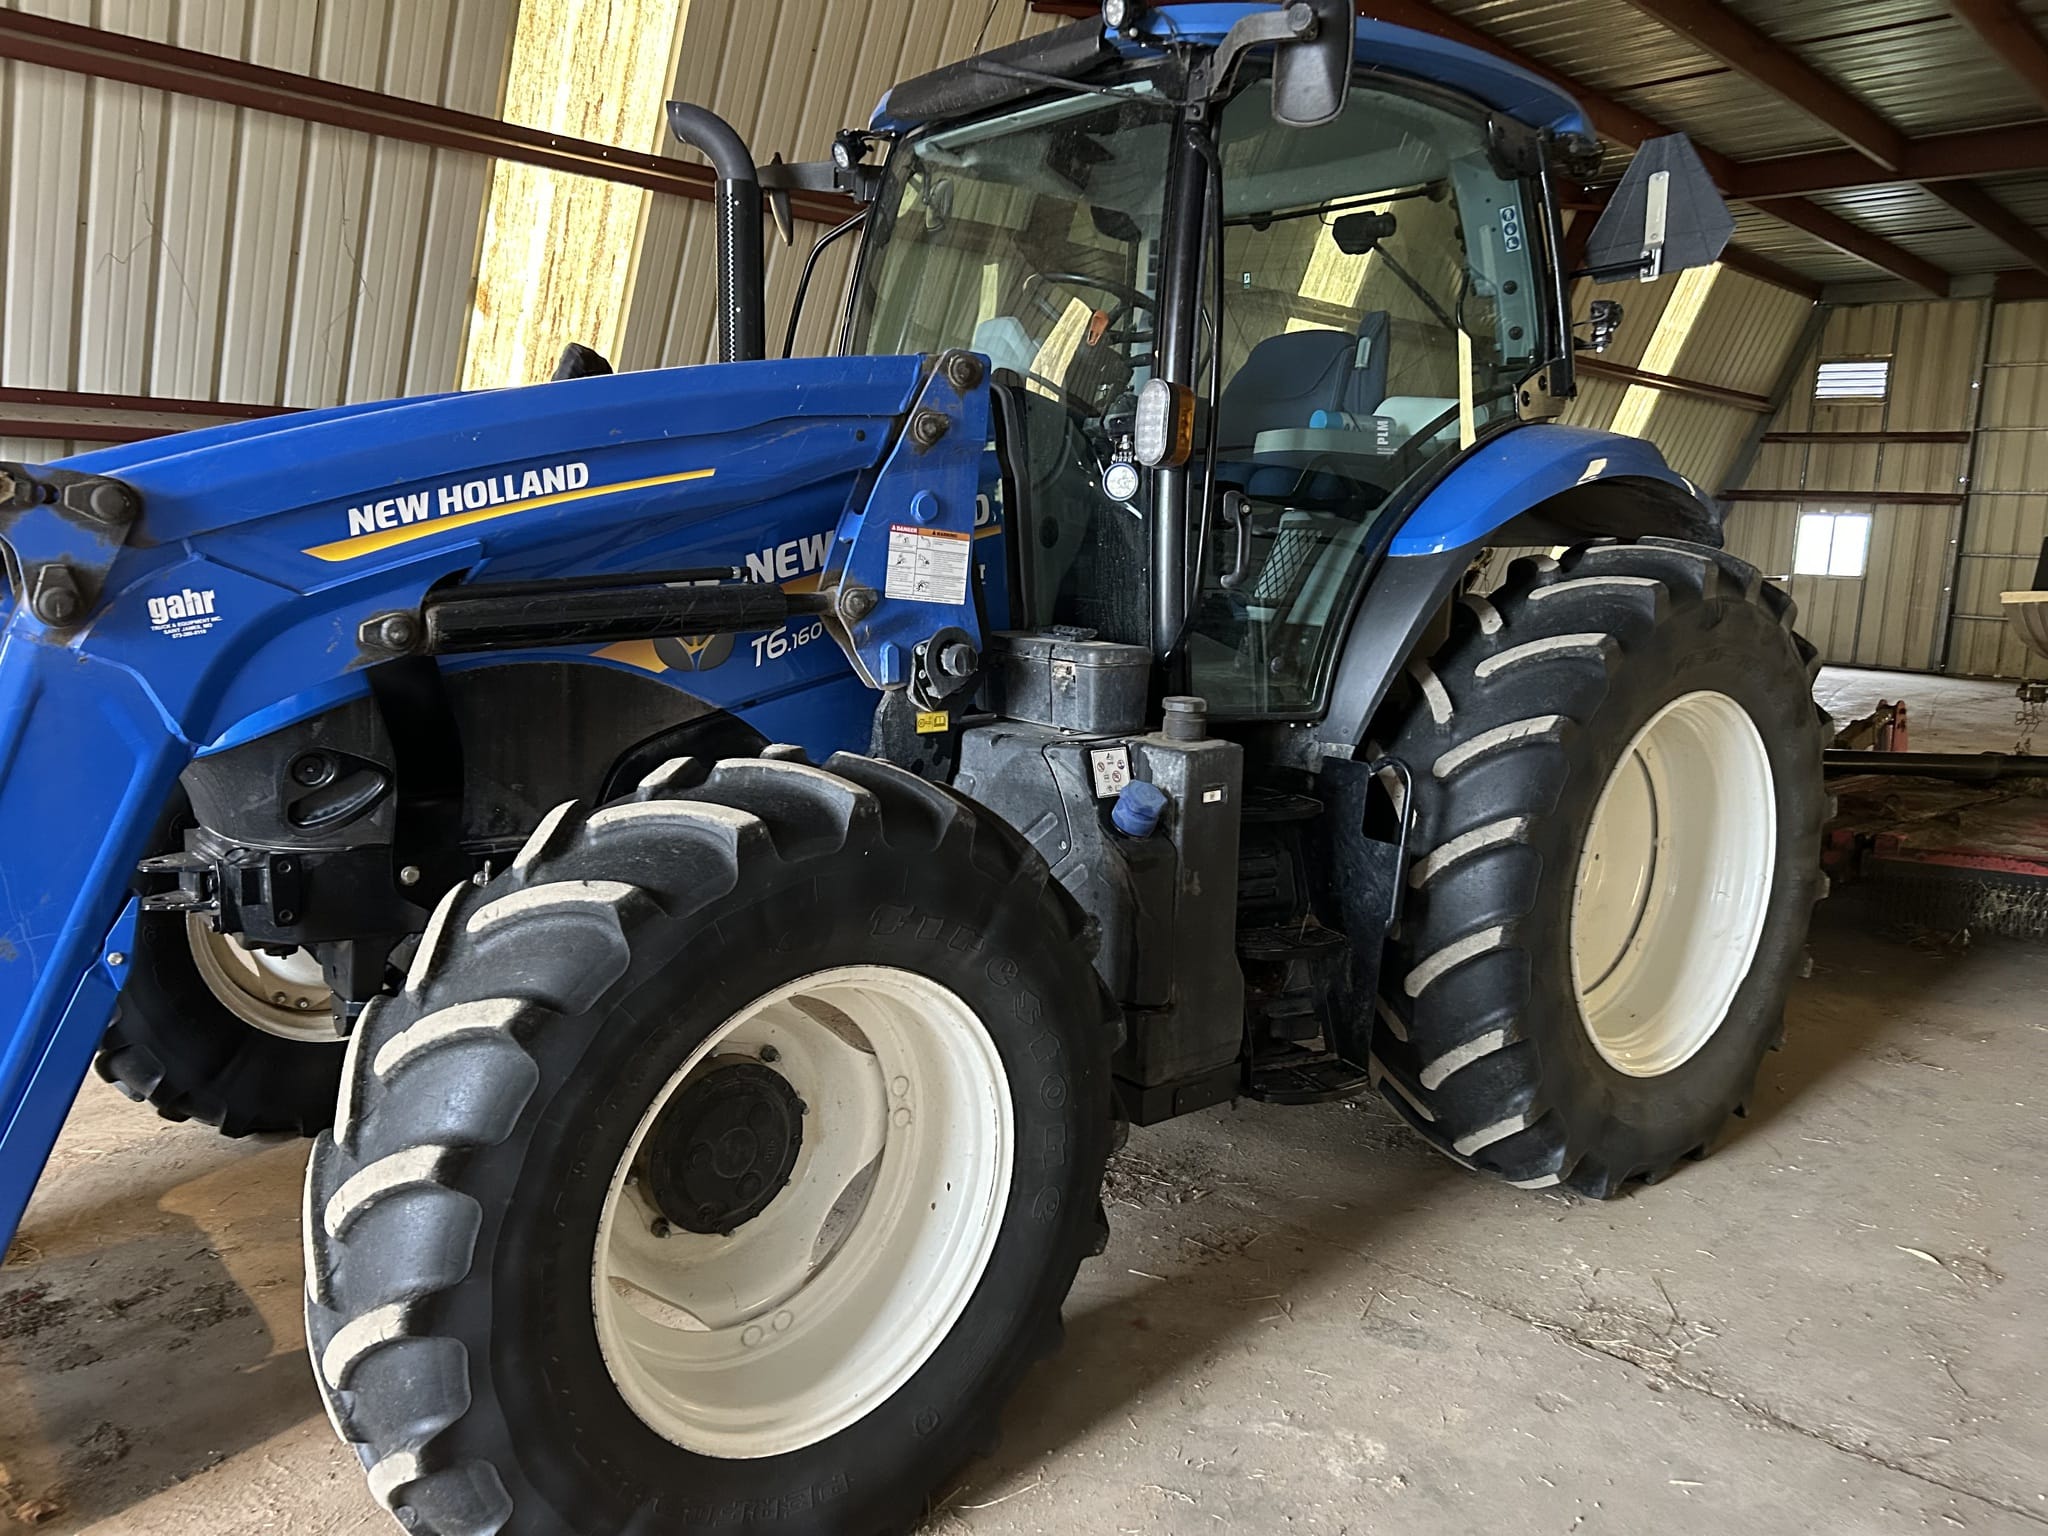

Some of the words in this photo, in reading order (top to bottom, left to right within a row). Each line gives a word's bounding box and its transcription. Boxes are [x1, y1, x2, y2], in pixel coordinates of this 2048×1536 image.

[348, 491, 429, 536] NEW
[437, 462, 589, 515] HOLLAND
[745, 530, 835, 584] NEW
[148, 588, 215, 625] gahr
[751, 622, 823, 668] T6.160
